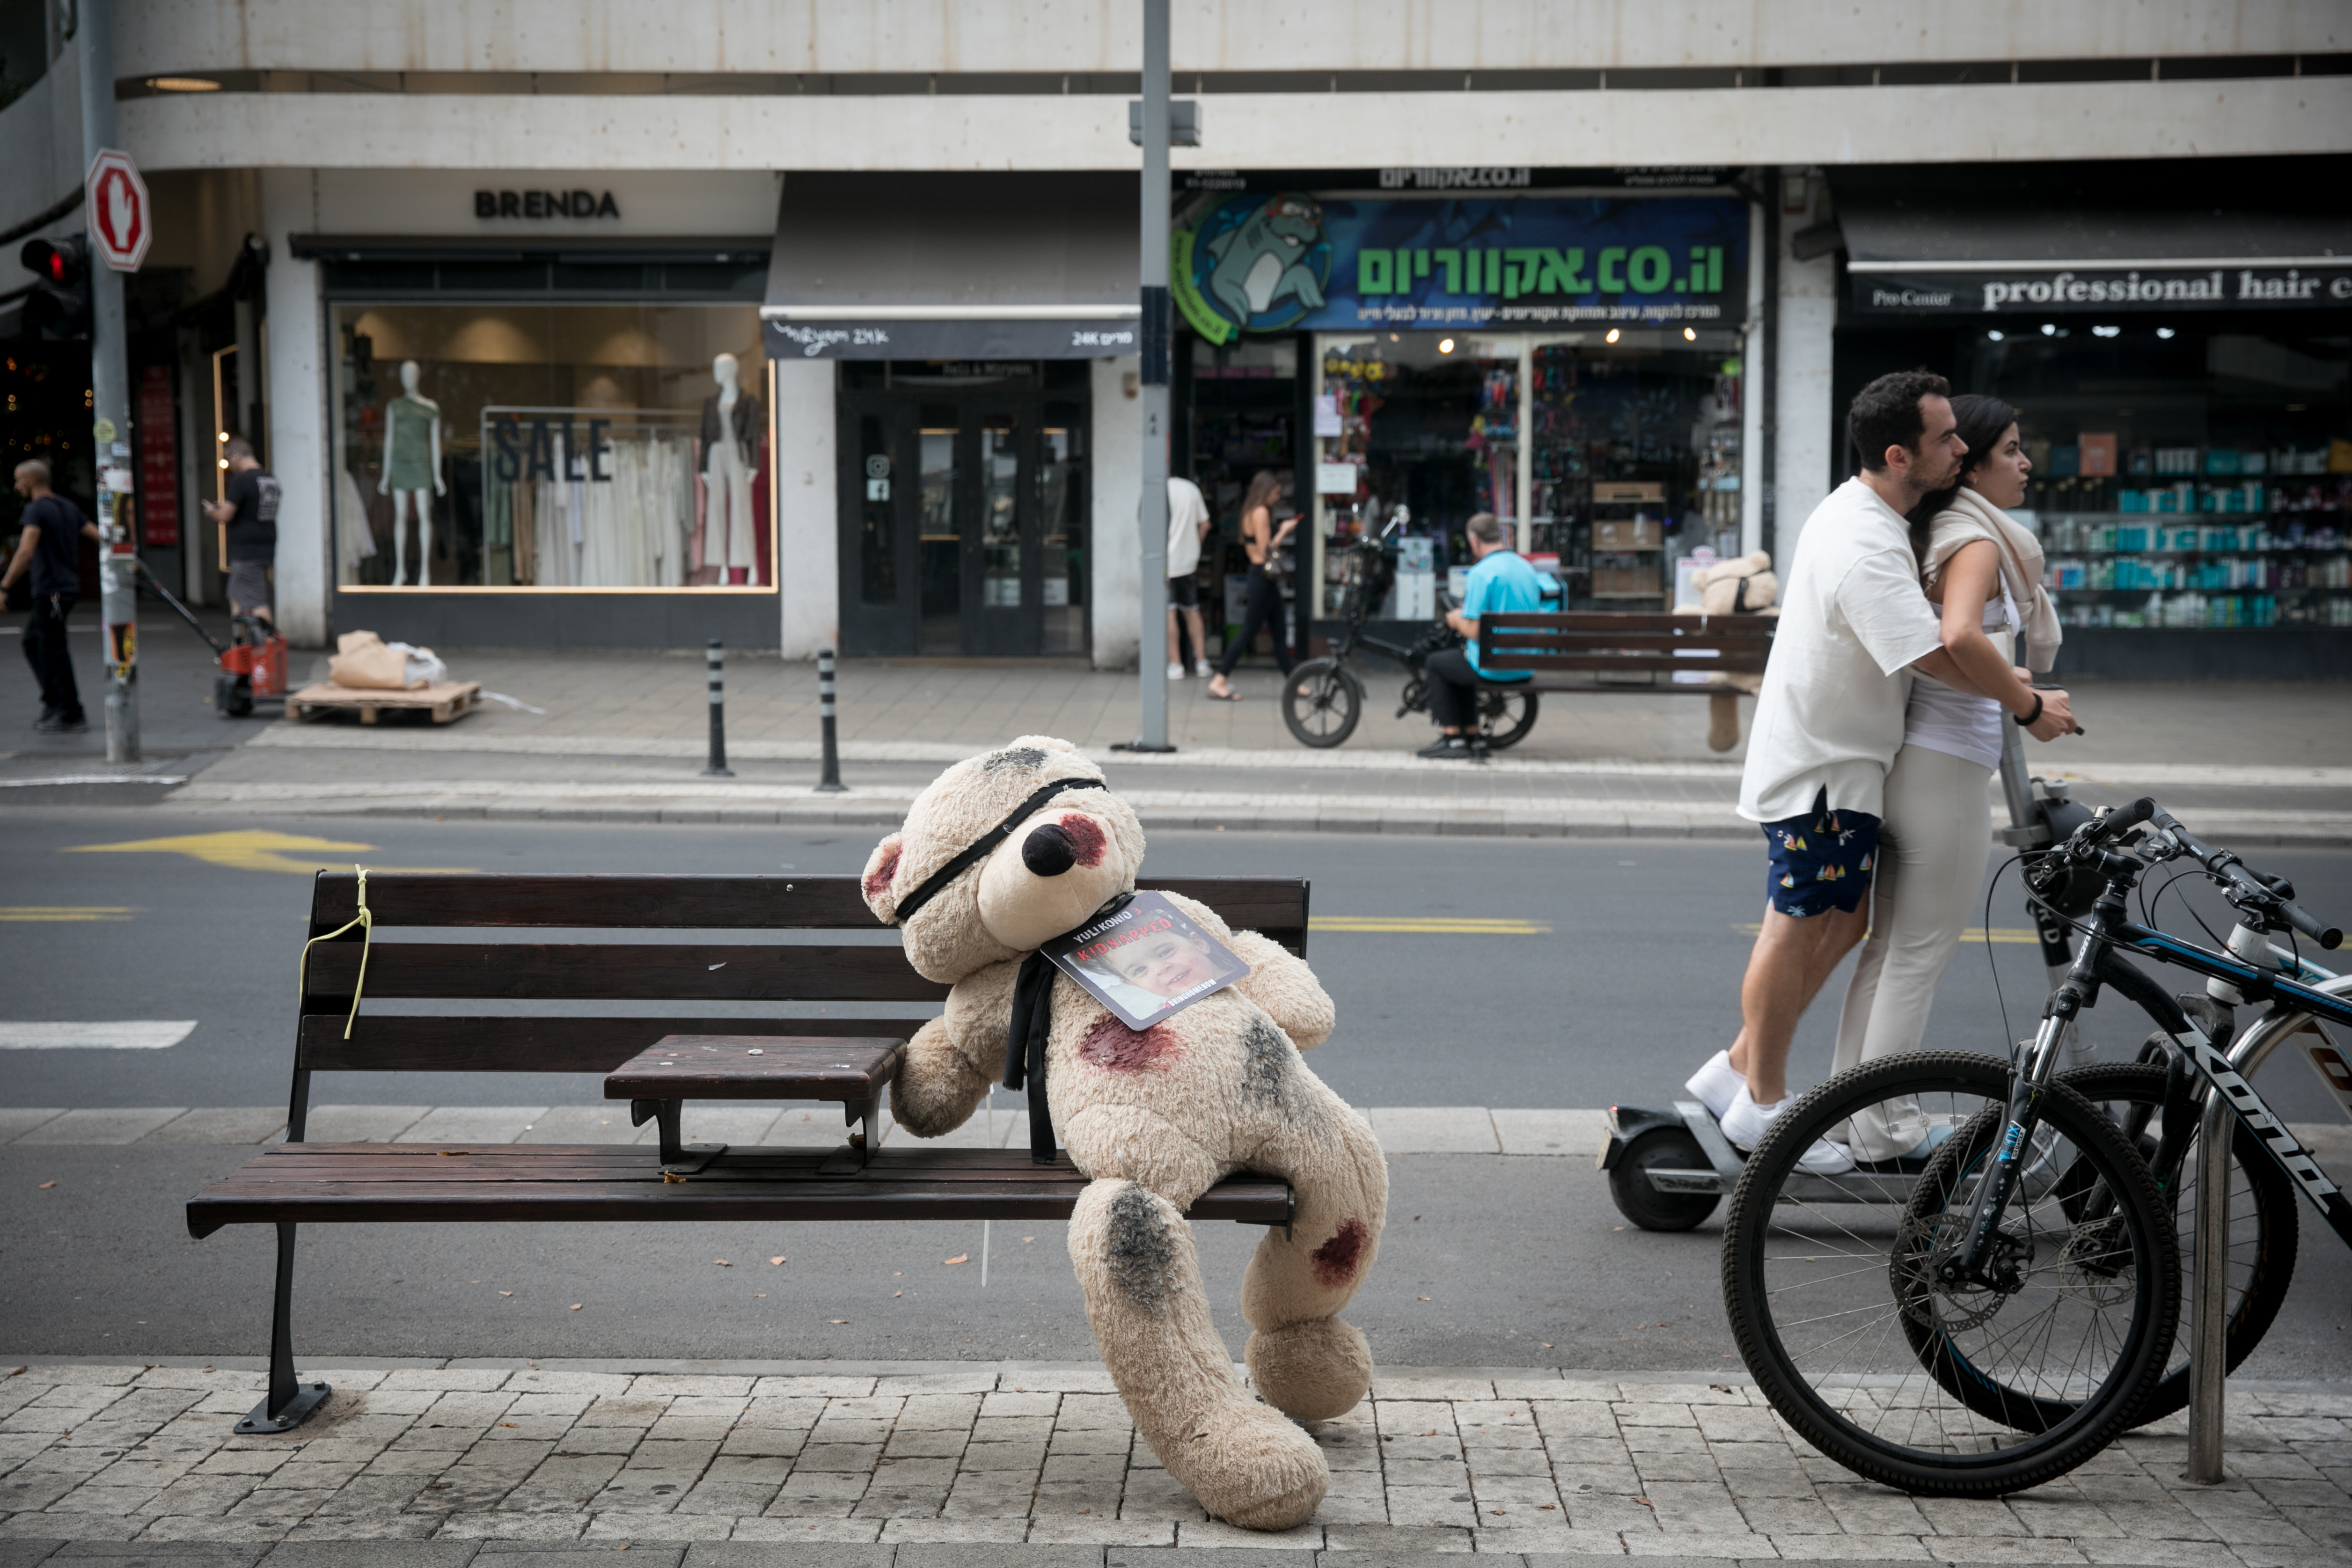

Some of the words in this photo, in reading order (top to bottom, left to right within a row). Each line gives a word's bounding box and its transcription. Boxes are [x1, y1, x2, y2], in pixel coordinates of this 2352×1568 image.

[475, 191, 619, 219] BRENDA
[1873, 289, 1900, 306] Pro
[1901, 289, 1954, 306] Center
[1983, 270, 2224, 311] professional
[2238, 269, 2319, 300] hair
[1071, 331, 1099, 346] 24K
[1100, 331, 1133, 345] מרים
[494, 418, 612, 483] SALE
[1073, 926, 1101, 944] YULI
[1099, 910, 1133, 931] KONIO
[1132, 907, 1143, 916] 3
[1076, 917, 1173, 962] KIDNAPPED
[1164, 978, 1217, 1009] #BRINGHOMENOW
